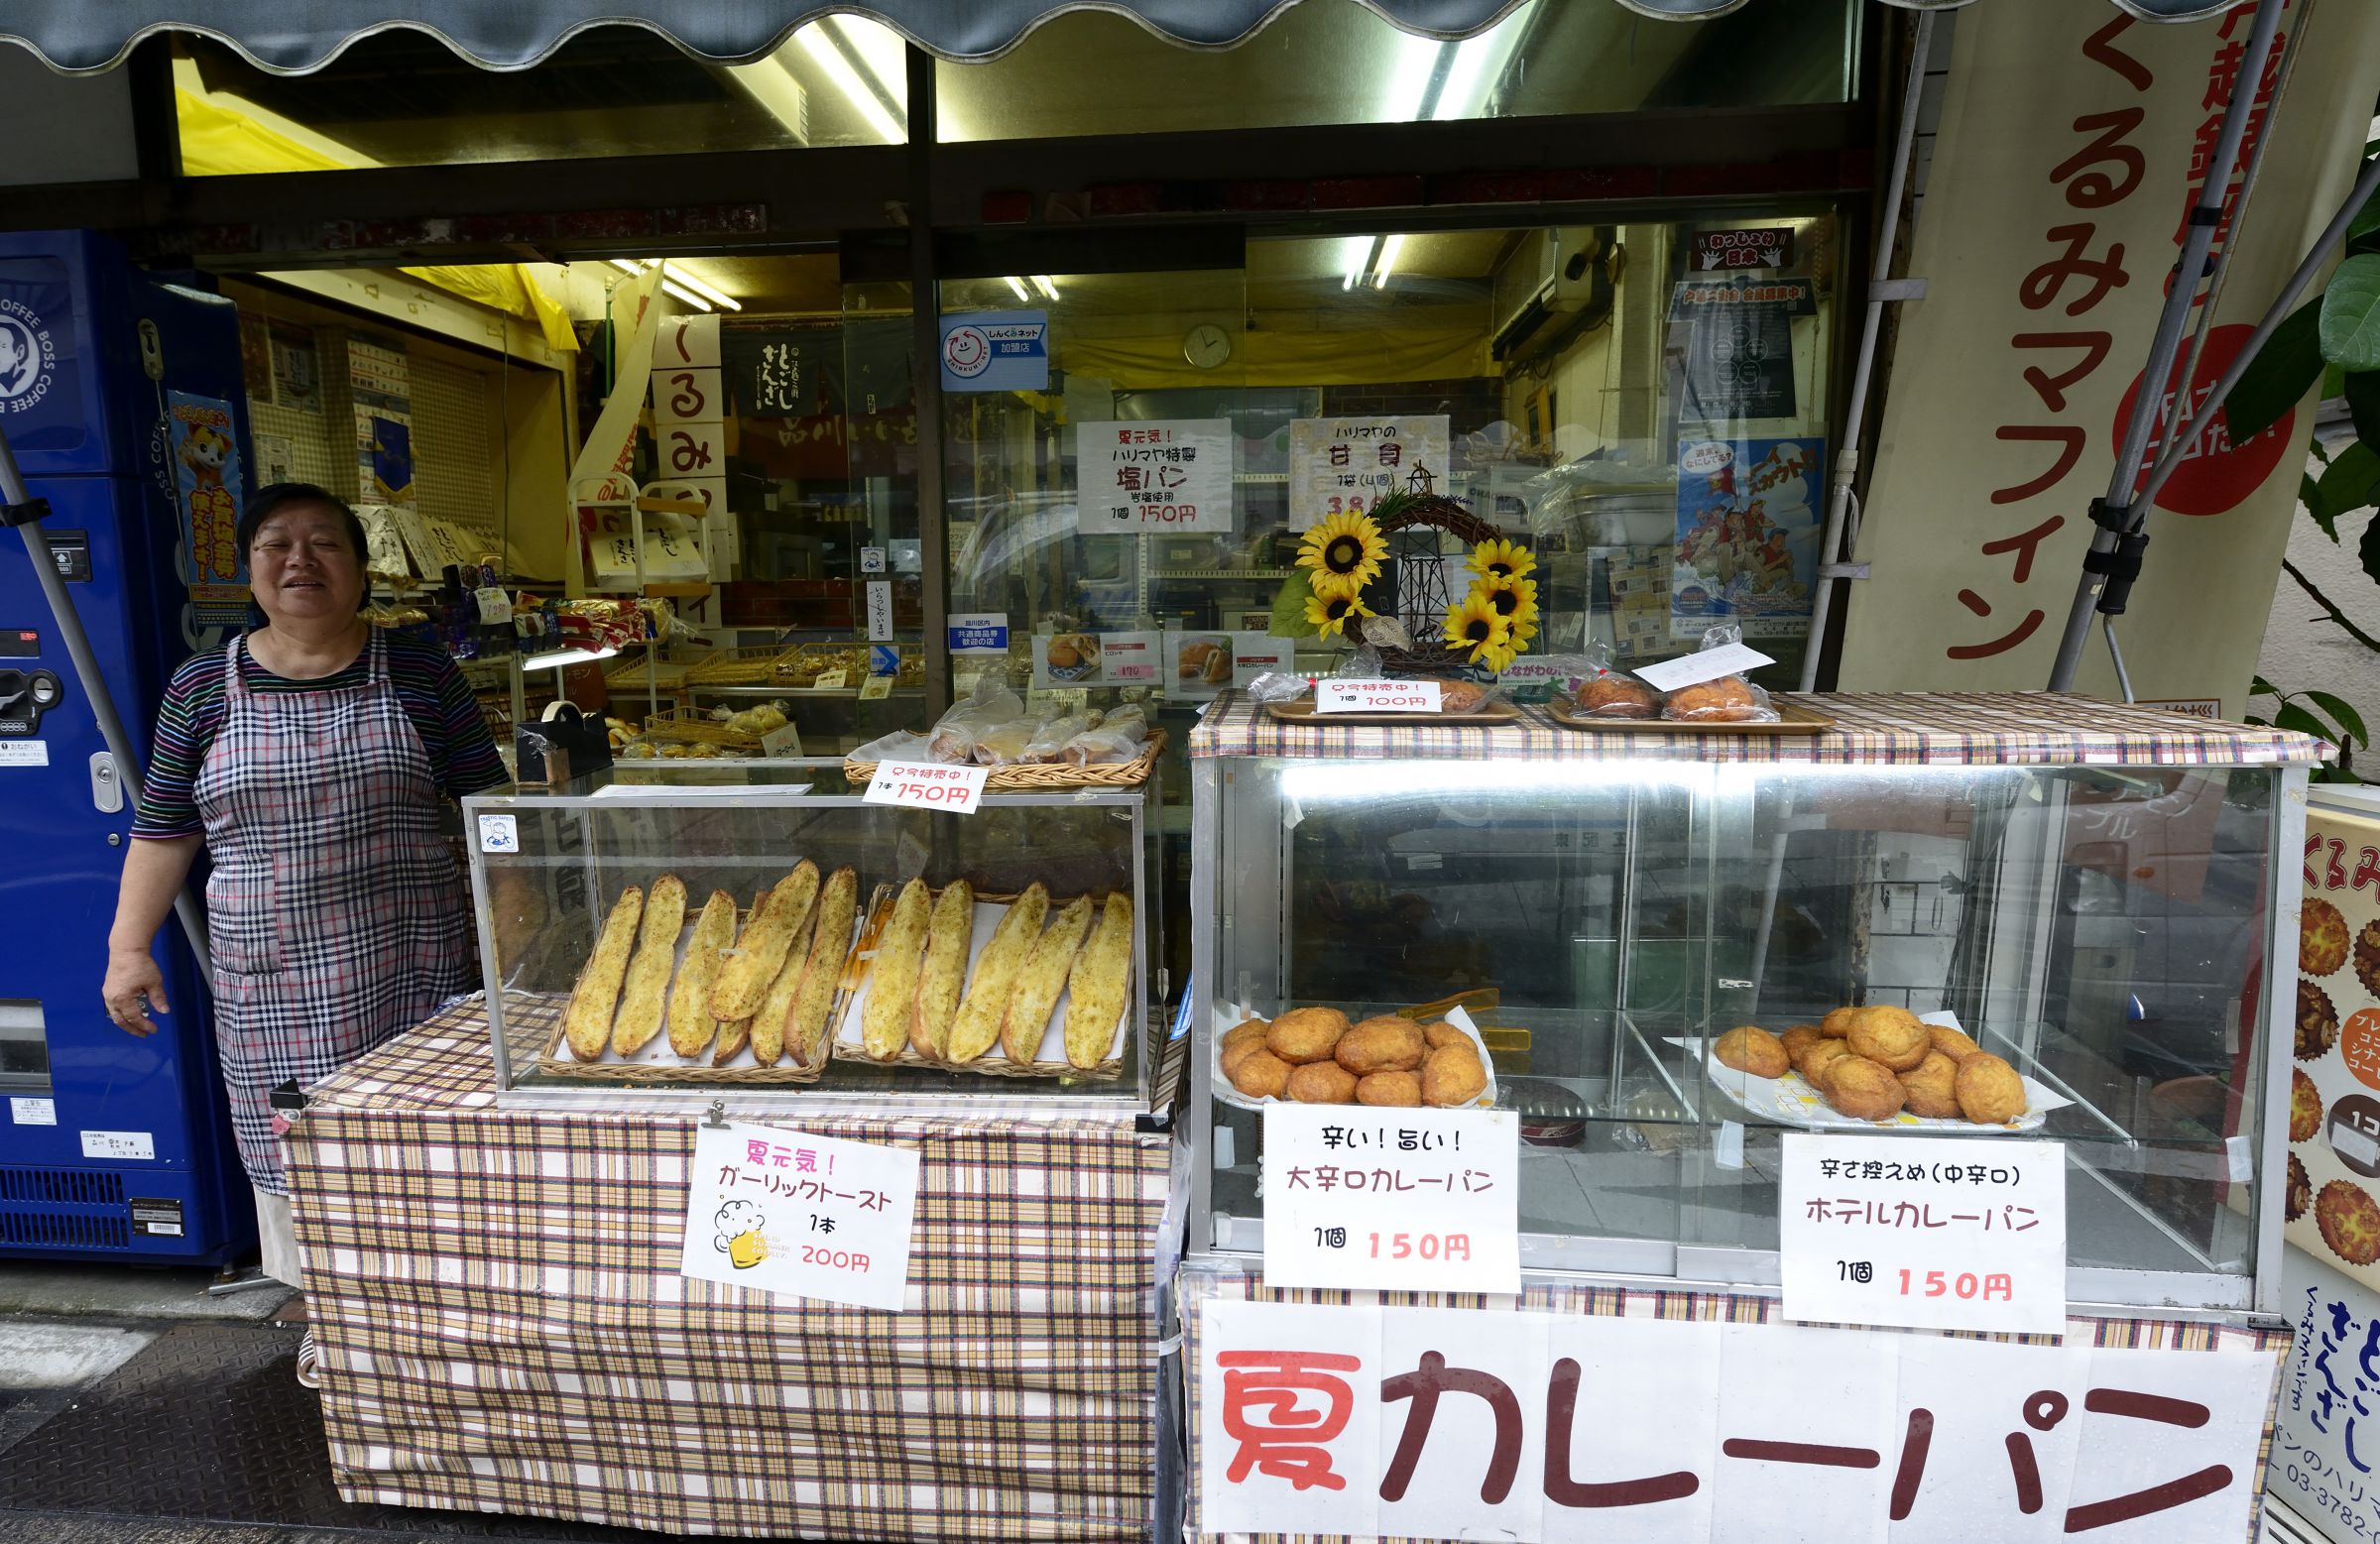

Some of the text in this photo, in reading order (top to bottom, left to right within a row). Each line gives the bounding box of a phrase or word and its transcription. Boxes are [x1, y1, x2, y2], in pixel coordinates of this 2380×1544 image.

[37, 330, 56, 370] BOSS
[989, 329, 1038, 338] しんくみネット
[1001, 342, 1030, 353] 加盟店
[1946, 12, 2154, 660] くるみマフィン
[762, 344, 779, 406] ぎんざ
[778, 343, 793, 411] とごし
[11, 376, 53, 414] COFFEE
[1336, 425, 1396, 438] ハリマヤの
[1113, 446, 1197, 462] ハリマヤ特製
[1686, 452, 1731, 468] なにしてる?
[1117, 465, 1187, 491] 塩パン
[1111, 505, 1197, 523] 1個 150円
[1366, 696, 1427, 706] 100円
[892, 767, 972, 780] 只今特売中!
[896, 782, 970, 804] 150円
[747, 1138, 836, 1175] 夏元気!
[718, 1164, 892, 1212] ガーリックトースト
[1285, 1161, 1495, 1195] 大辛口カレーパン
[809, 1214, 836, 1235] 1本
[1806, 1195, 2040, 1234] ホテルカレーパン
[801, 1245, 871, 1273] 200円
[1312, 1225, 1473, 1262] 1個 150円
[1837, 1259, 2013, 1302] 1個 150円
[2311, 1301, 2361, 1434] ぎんざ
[1221, 1350, 2235, 1535] 夏カレーパン
